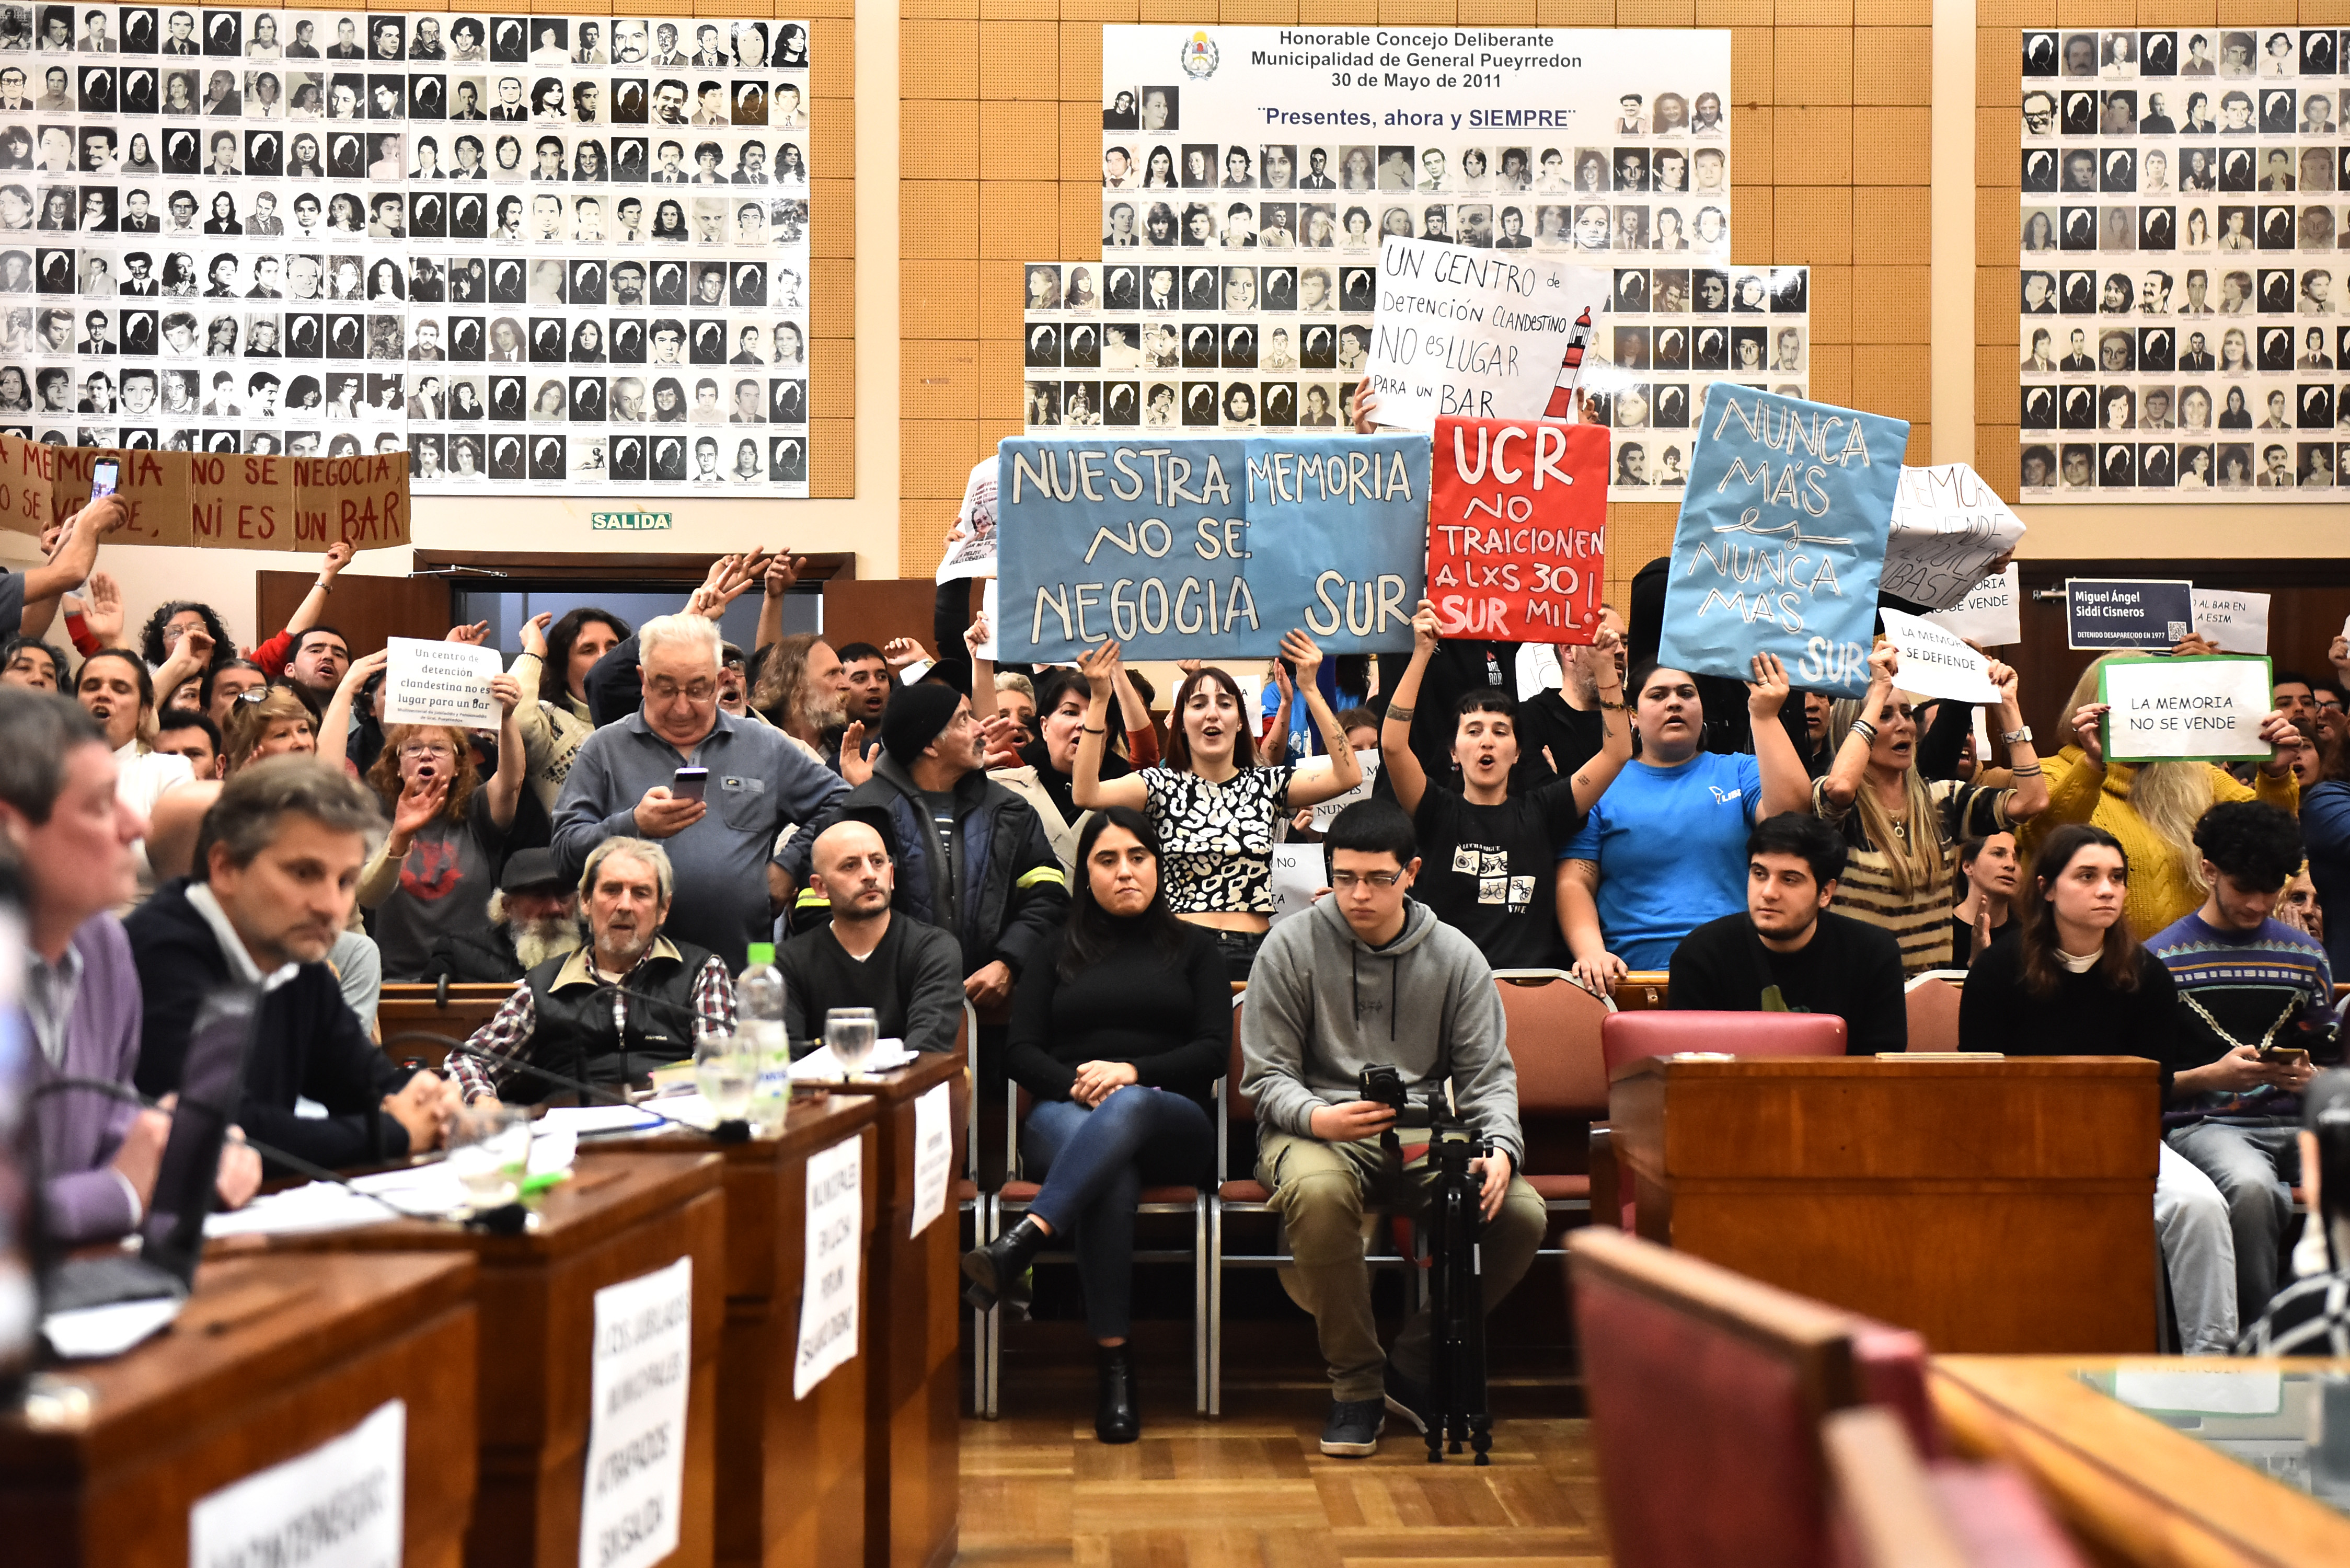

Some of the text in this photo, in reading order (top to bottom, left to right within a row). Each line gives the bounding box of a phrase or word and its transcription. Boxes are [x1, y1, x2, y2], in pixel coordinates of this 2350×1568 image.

[1280, 31, 1553, 50] Honorable Concejo Deliberante
[1252, 51, 1582, 71] Municipalidad de General Pueyrredon
[1332, 72, 1501, 90] 30 de Mayo de 2011
[1384, 109, 1444, 126] ahora
[1450, 113, 1462, 131] y
[1386, 244, 1560, 297] UN CENTRO de
[1378, 324, 1519, 377] NO es LUGAR
[1373, 374, 1495, 419] PARA UN BAR
[1713, 398, 1871, 467] NUNCA
[1454, 425, 1575, 491] UCR
[193, 460, 225, 485] NO
[245, 457, 279, 485] SE
[1012, 447, 1413, 507] NUESTRA MEMORIA
[1717, 456, 1829, 517] MÁS
[22, 489, 41, 520] SE
[193, 498, 222, 537] NI
[239, 505, 275, 539] ES
[296, 512, 326, 541] UN
[341, 491, 400, 541] BAR
[1463, 492, 1534, 523] NO
[593, 514, 670, 529] SALIDA
[1085, 517, 1252, 564] NO SE
[1437, 524, 1605, 559] TRAICIONEN
[1435, 563, 1459, 587] A
[1528, 562, 1579, 594] 30
[1688, 541, 1842, 596] NUNCA
[1030, 570, 1413, 644] NEGOCIA SUR
[1968, 595, 2009, 609] VENDE
[2075, 589, 2140, 605] Miguel Ángel
[2199, 600, 2246, 611] AL BAR EN
[1441, 594, 1511, 637] SUR
[1697, 587, 1803, 633] MÁS
[2076, 606, 2145, 617] Siddi Cisneros
[2206, 613, 2231, 624] ESIM
[1902, 627, 1915, 638] LA
[416, 649, 479, 663] Un centro de
[1798, 636, 1871, 688] SUR
[1906, 647, 1976, 671] SE DEFIENDE
[421, 664, 473, 677] detención
[400, 678, 462, 692] clandestina
[465, 685, 477, 694] no
[398, 694, 427, 706] lugar
[429, 698, 454, 707] para
[456, 700, 470, 708] un
[2132, 696, 2233, 710] LA MEMORIA
[2130, 716, 2236, 730] NO SE VENDE
[1277, 857, 1296, 868] NO
